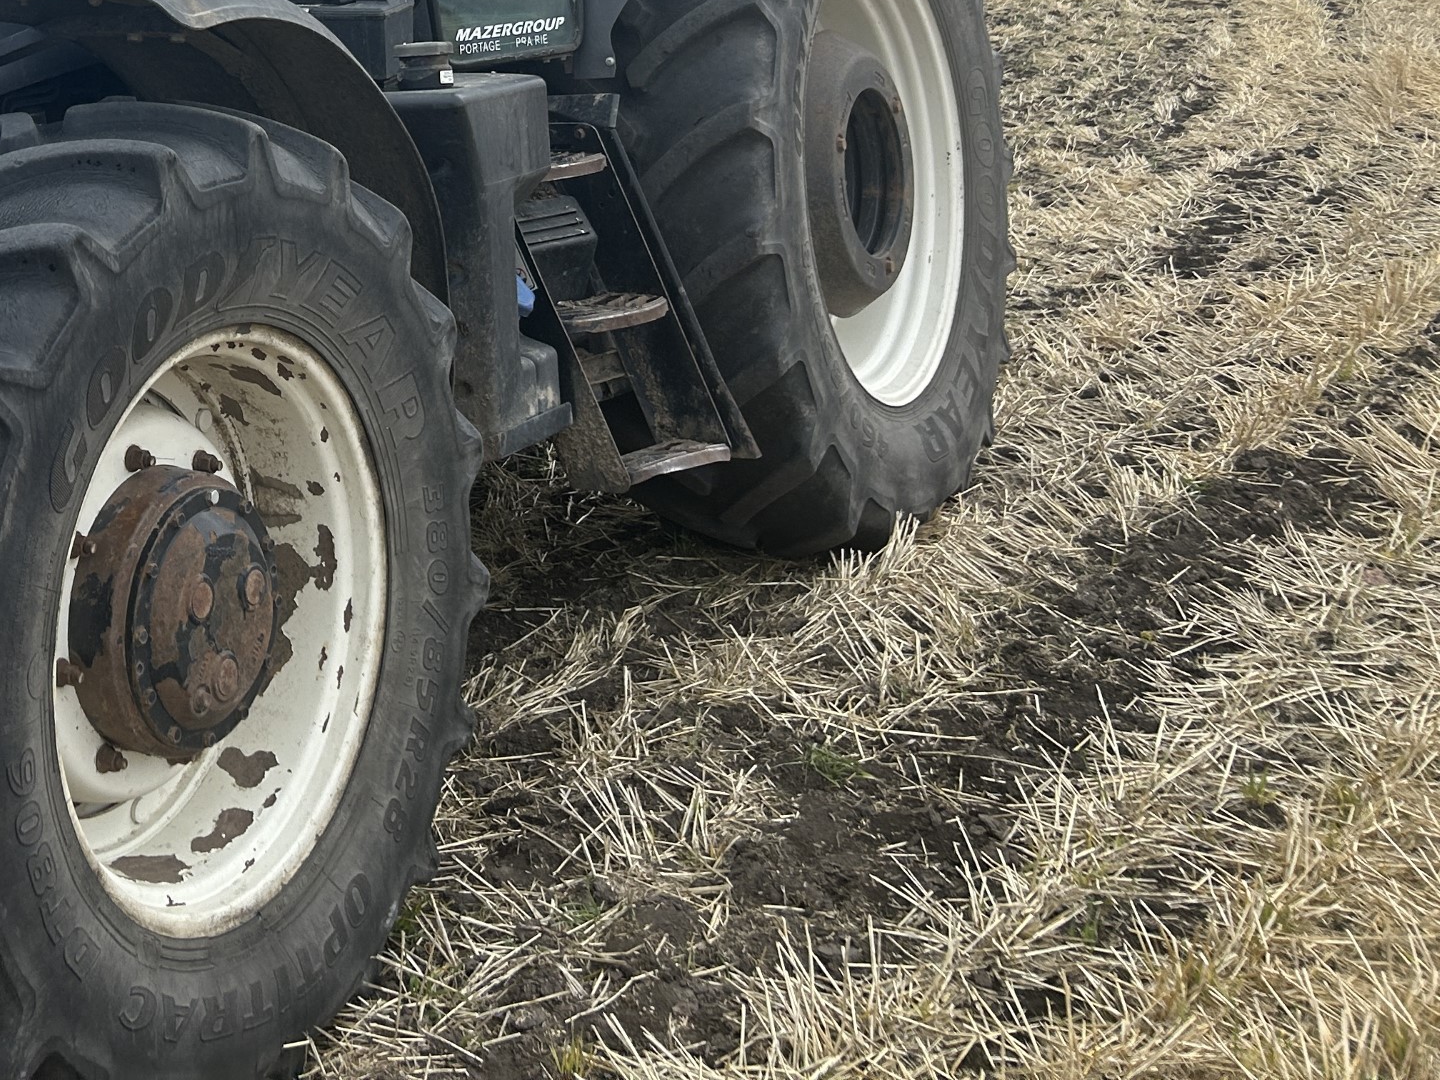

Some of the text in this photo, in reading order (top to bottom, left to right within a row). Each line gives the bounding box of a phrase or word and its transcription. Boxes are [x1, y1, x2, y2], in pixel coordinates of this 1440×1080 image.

[455, 16, 565, 41] MAZERGROUP
[459, 40, 501, 55] PORTAGE
[48, 234, 426, 514] GOODYEAR
[915, 67, 998, 463] GOODYEAR
[382, 483, 450, 843] 380/85R28
[118, 872, 372, 1042] OPTITRAC
